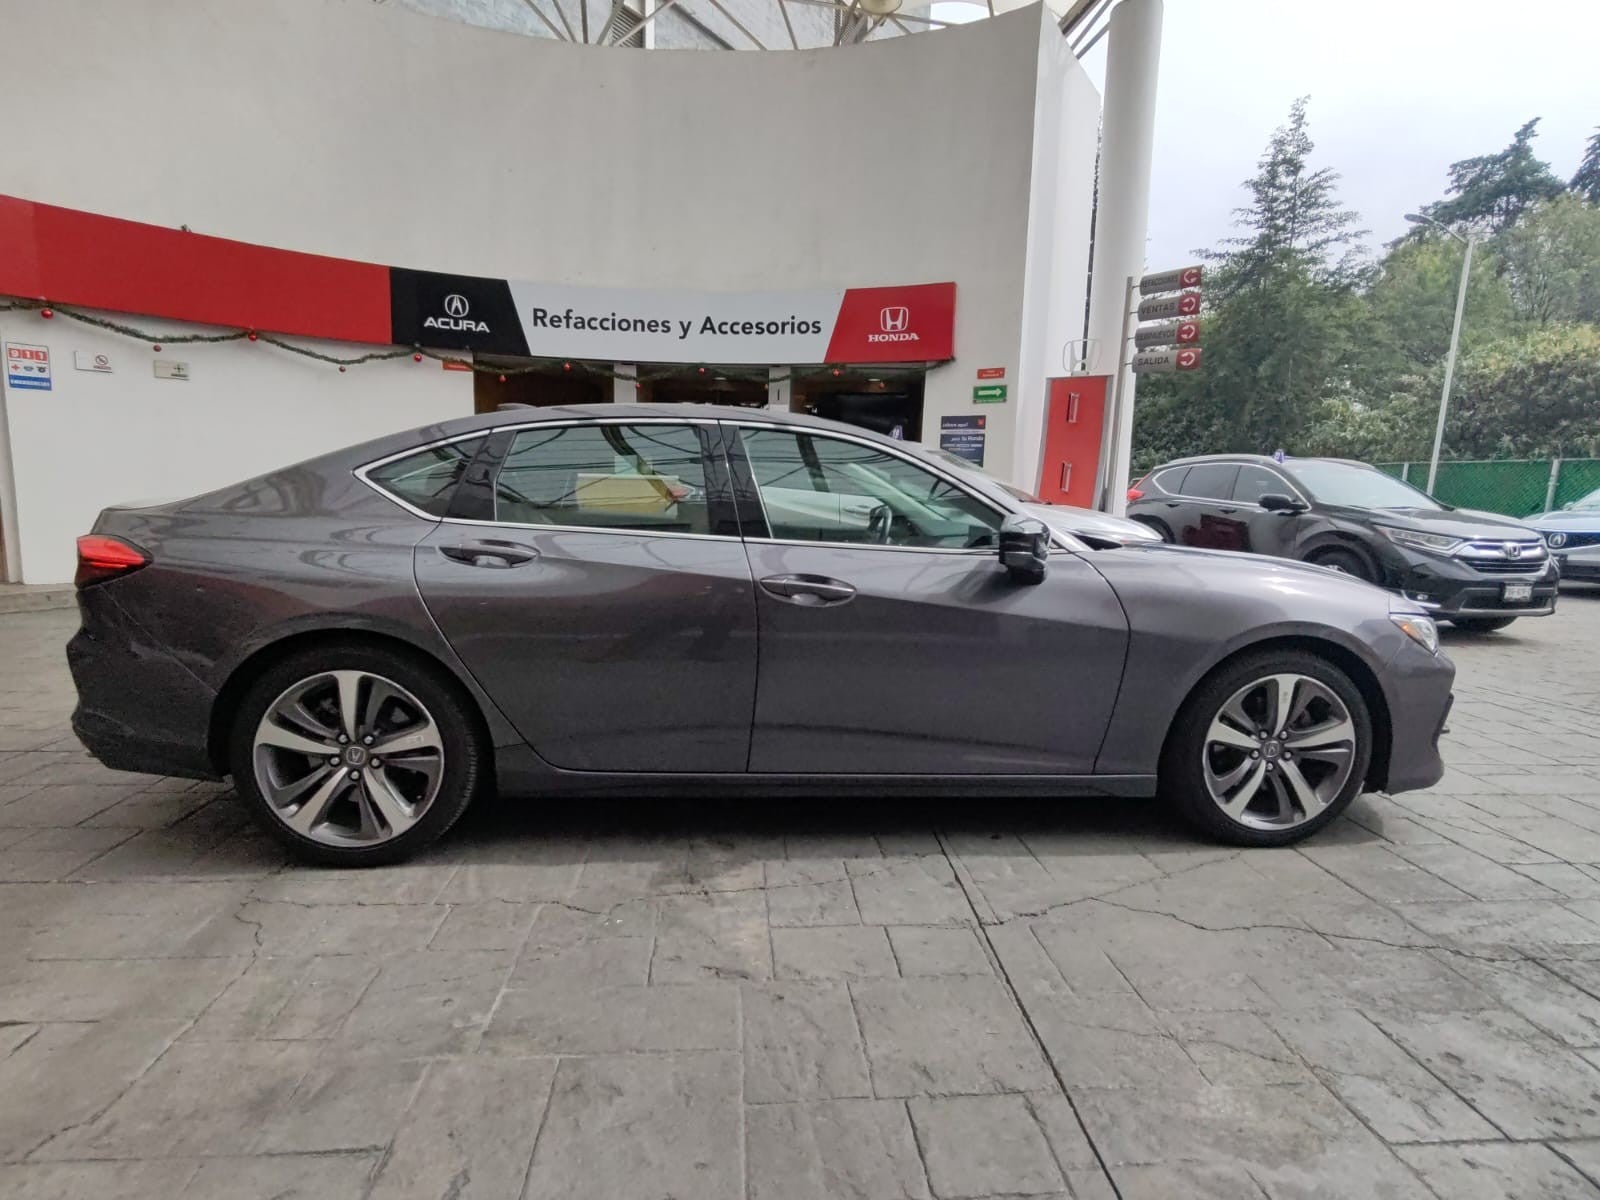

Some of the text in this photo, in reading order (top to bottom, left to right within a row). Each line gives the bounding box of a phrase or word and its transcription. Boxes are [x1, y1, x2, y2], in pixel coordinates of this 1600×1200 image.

[1141, 302, 1175, 314] VENTAS
[423, 316, 490, 333] ACURA
[532, 307, 822, 339] Refacciones y Accesorios
[867, 332, 920, 342] HONDA
[9, 349, 46, 360] 911
[1137, 356, 1169, 366] SALIDA
